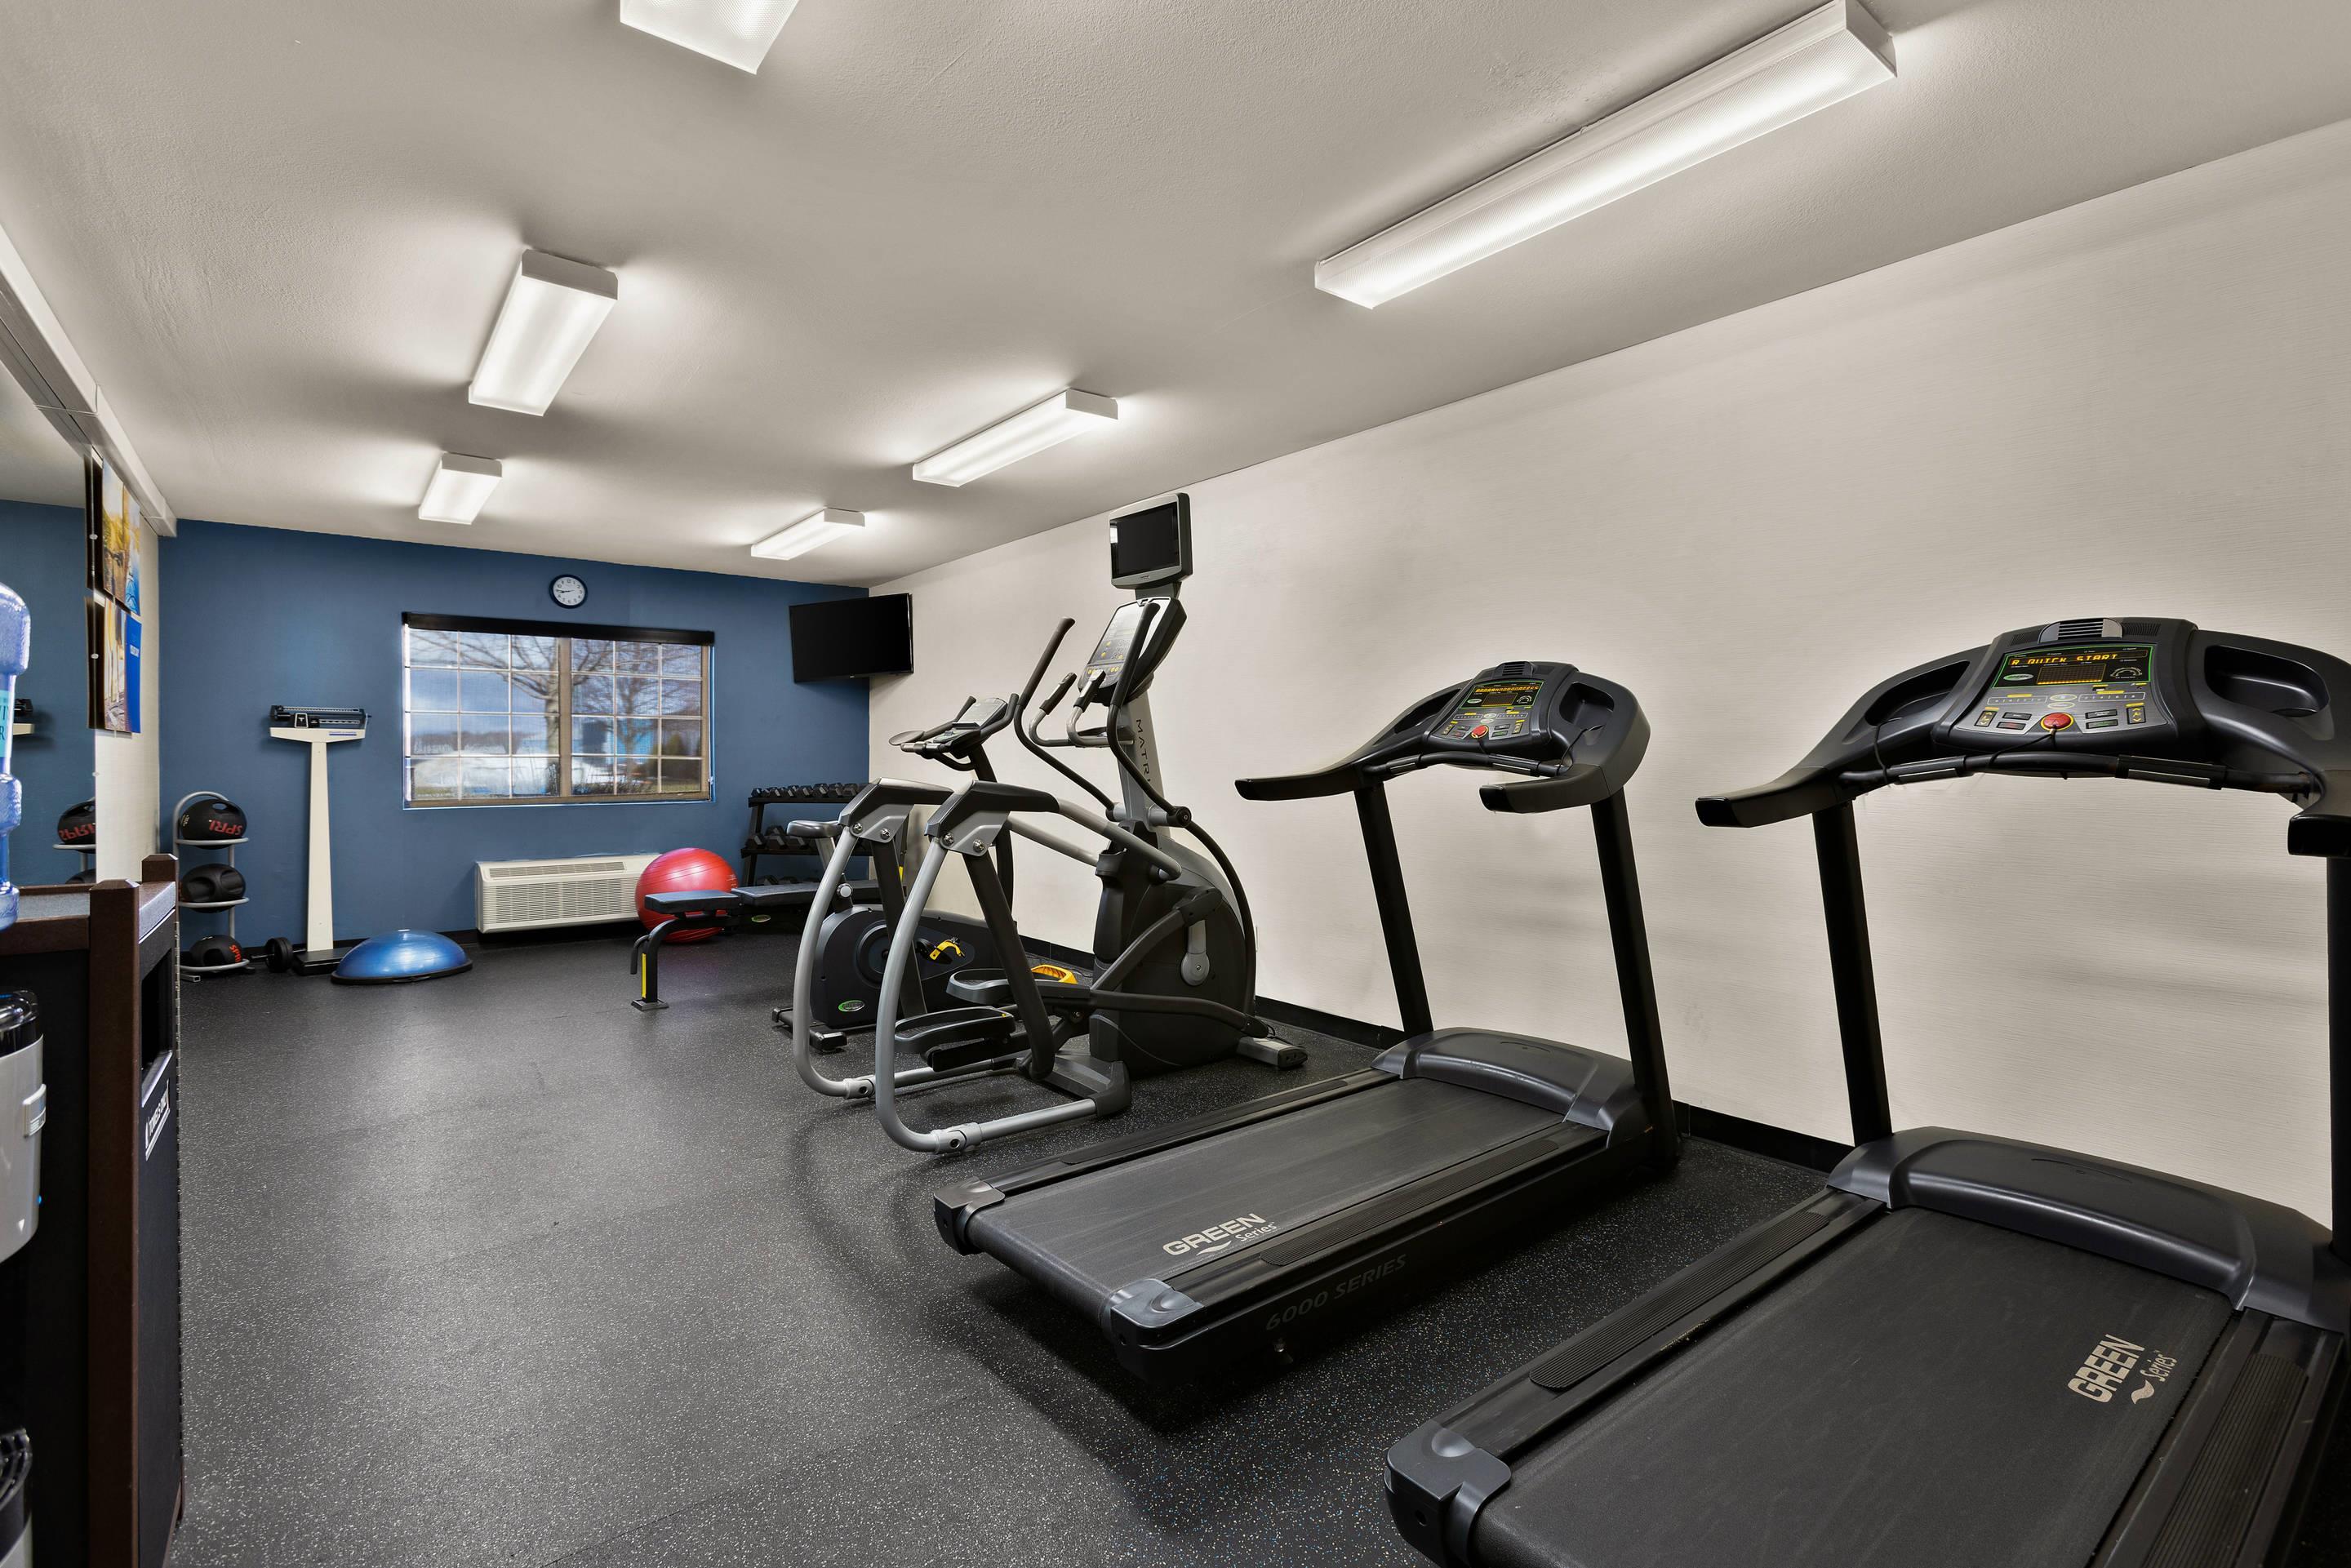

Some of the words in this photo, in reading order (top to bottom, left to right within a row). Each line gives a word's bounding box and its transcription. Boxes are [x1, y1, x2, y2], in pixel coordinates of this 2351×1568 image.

[1136, 719, 1151, 781] MATRI
[209, 820, 243, 836] SPRI
[1162, 1213, 1267, 1255] GREEN
[1235, 1223, 1277, 1242] Series
[1266, 1291, 1329, 1330] 6000
[1334, 1254, 1407, 1299] SERIES
[2067, 1334, 2145, 1403] GREEN
[2140, 1353, 2177, 1382] Series
